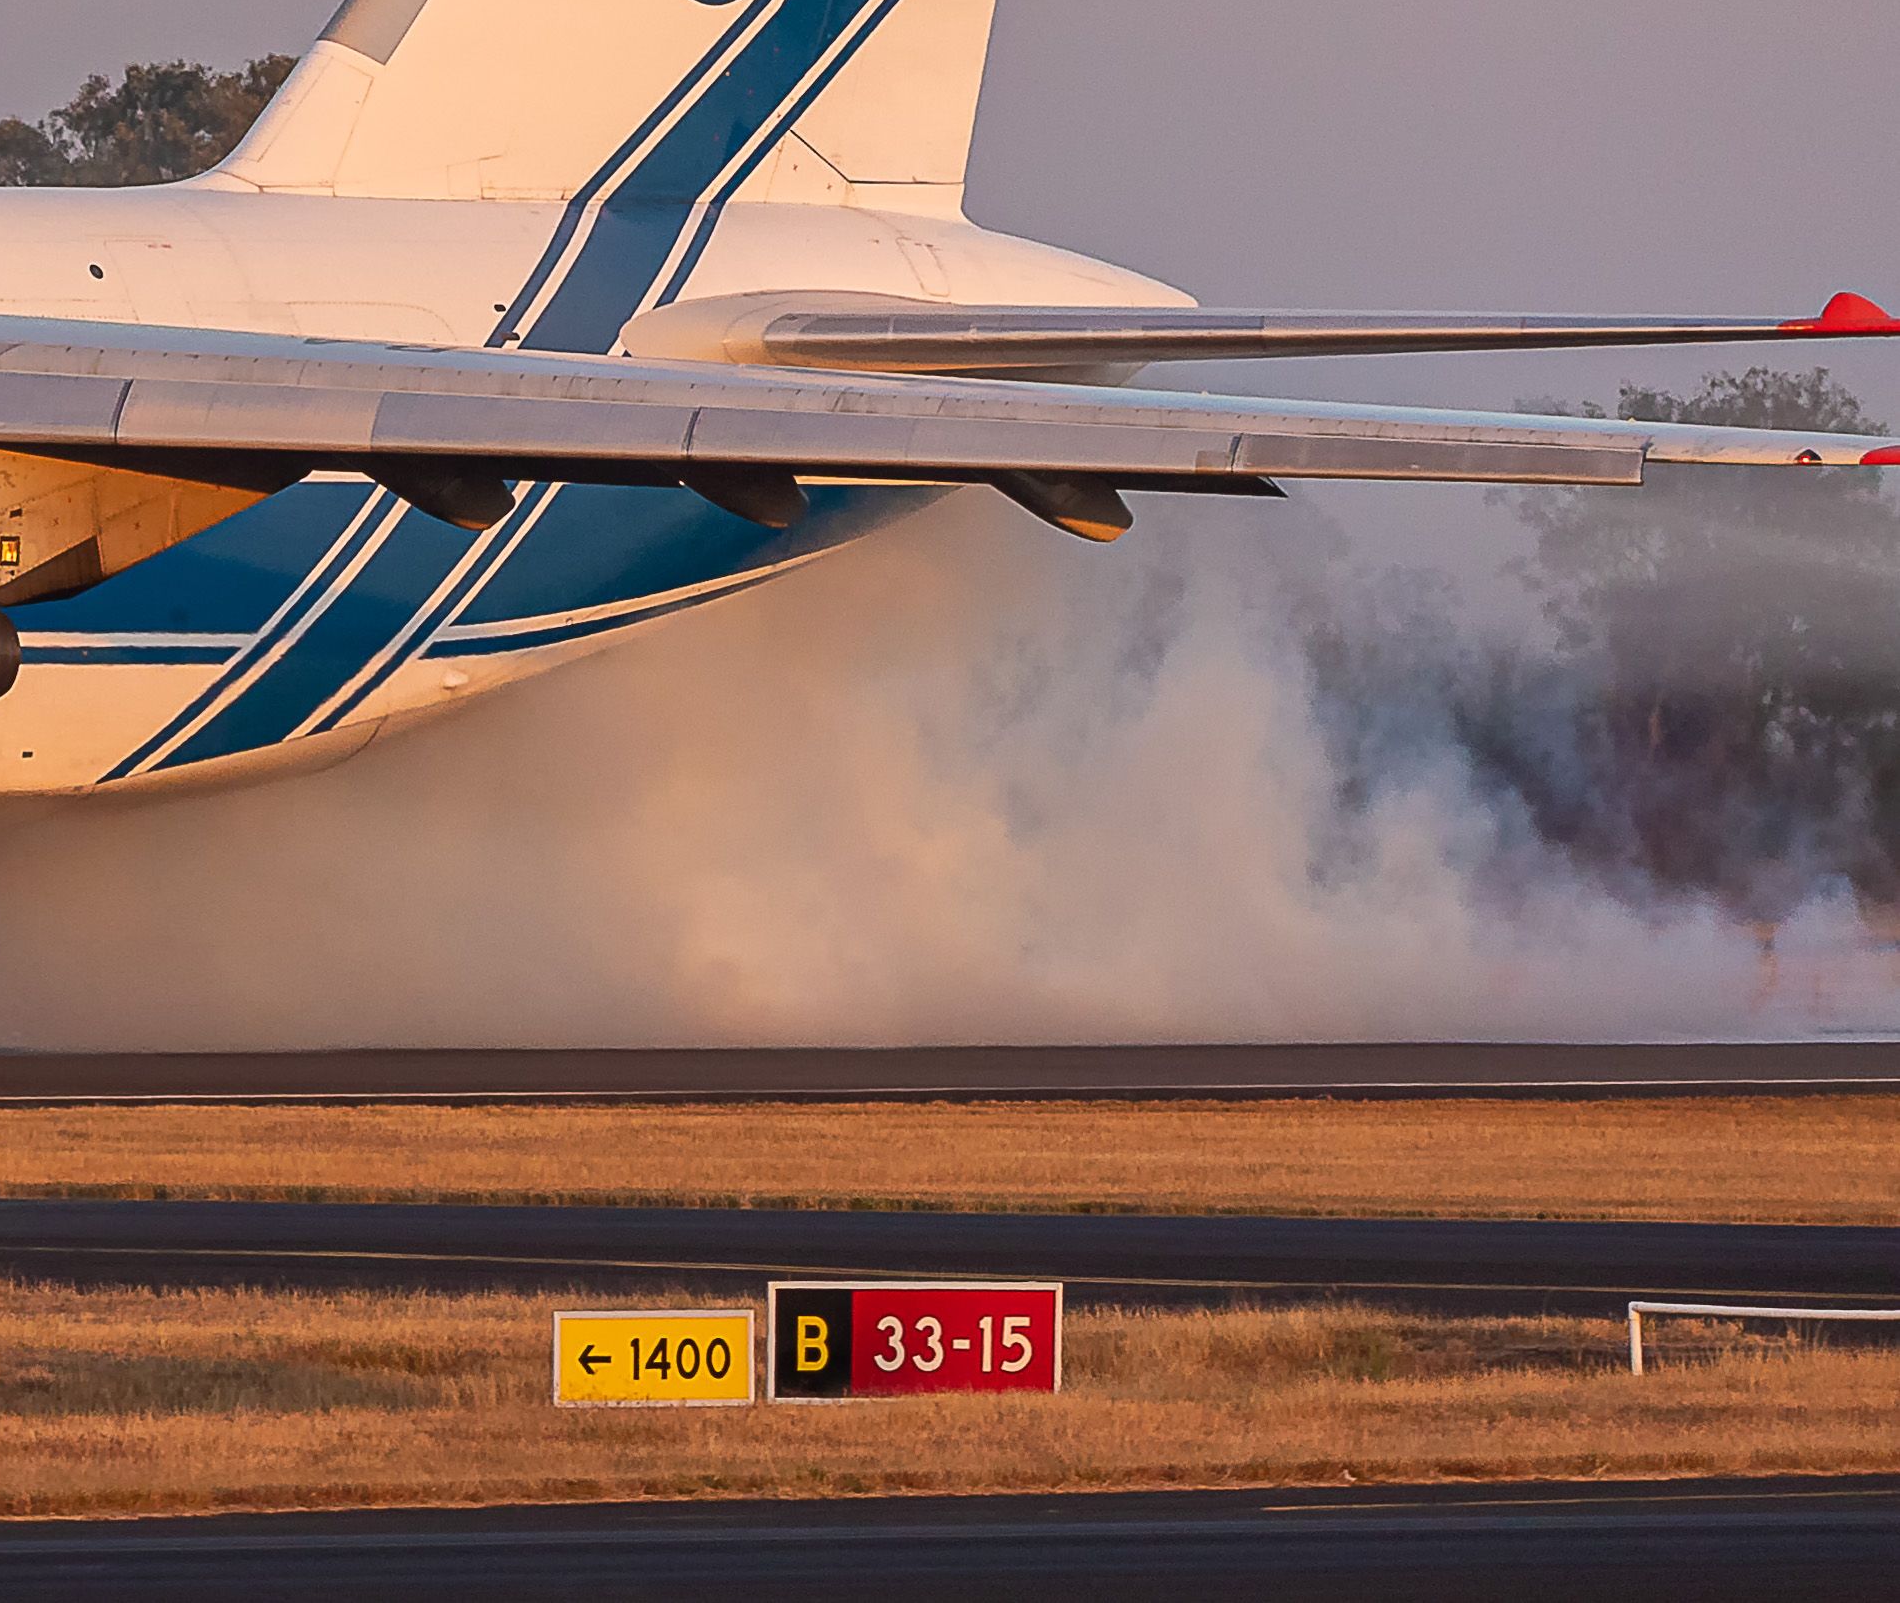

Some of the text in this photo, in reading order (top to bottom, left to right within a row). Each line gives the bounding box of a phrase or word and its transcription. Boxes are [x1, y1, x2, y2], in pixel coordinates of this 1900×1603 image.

[629, 1337, 731, 1381] 1400
[796, 1315, 1034, 1373] B 33-15
